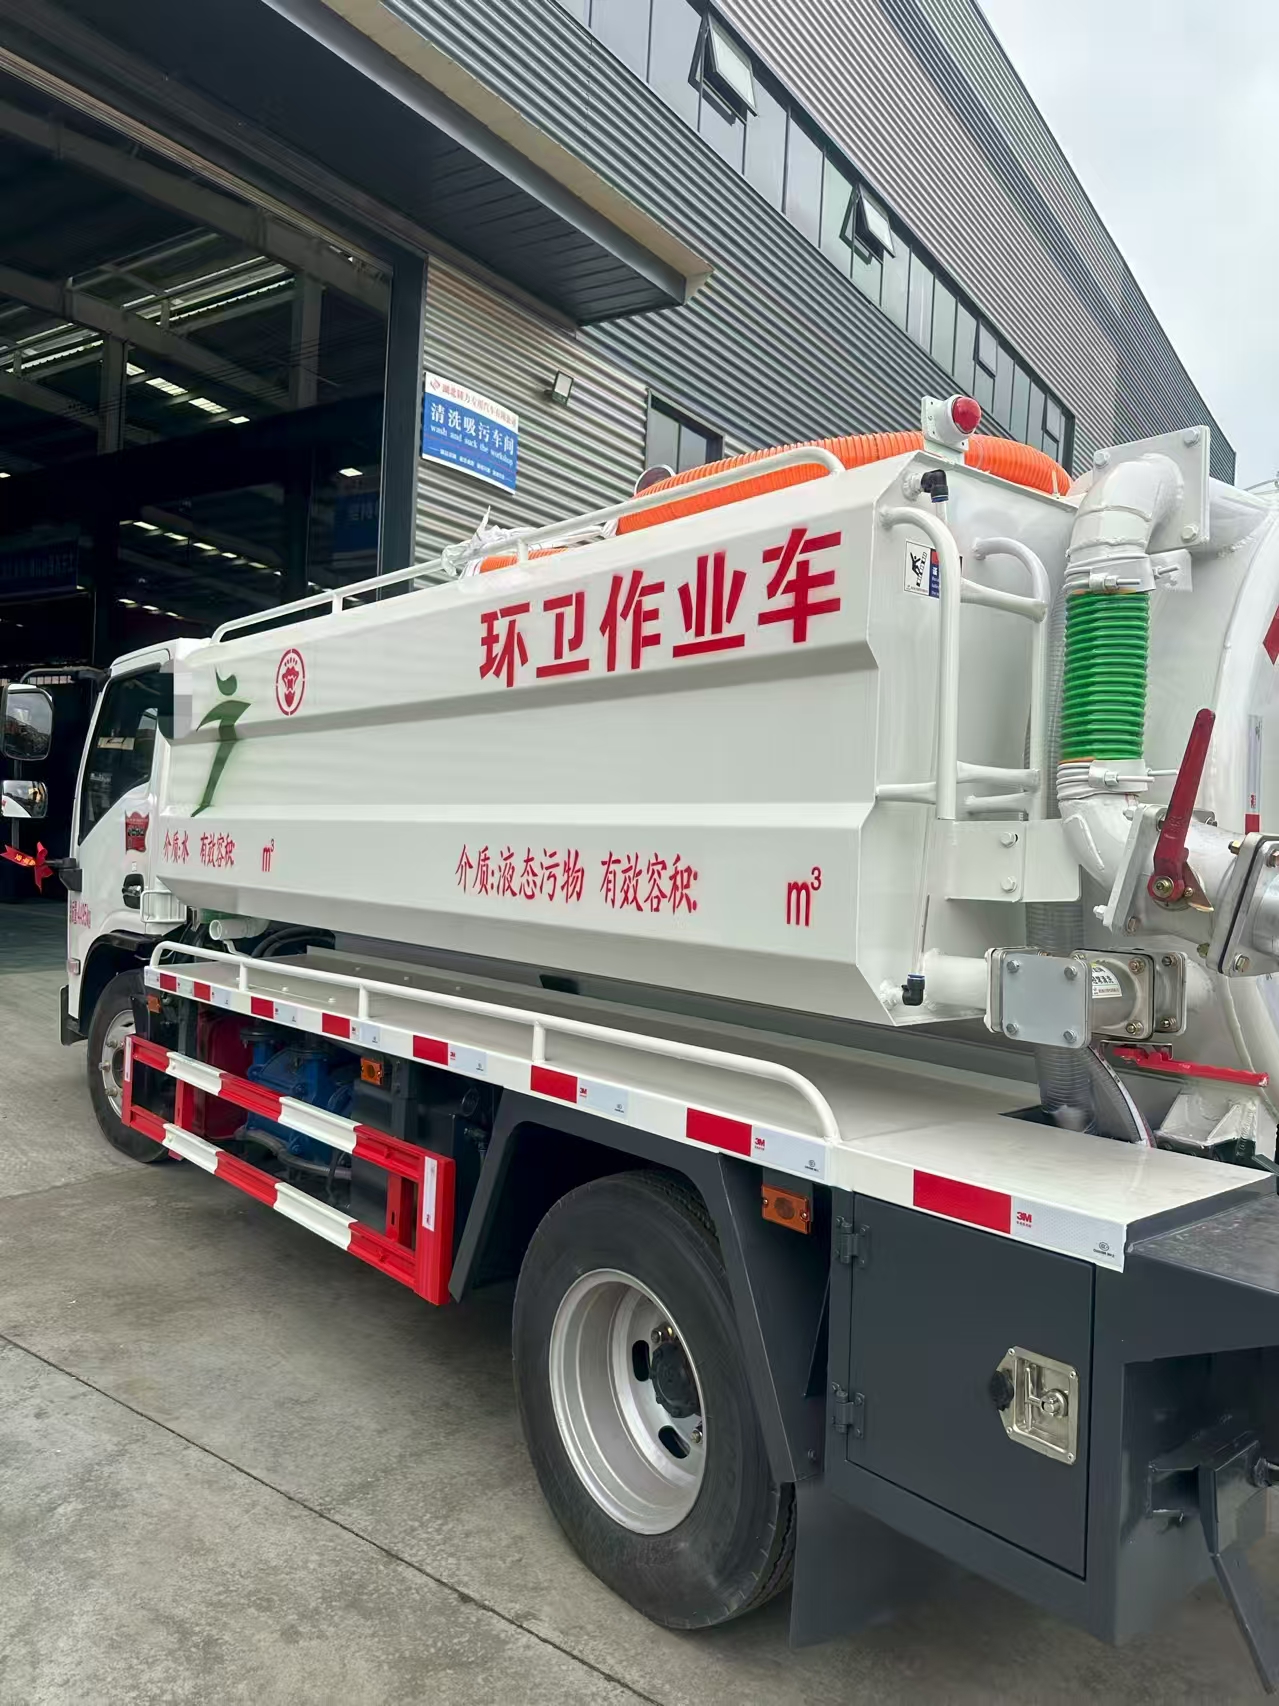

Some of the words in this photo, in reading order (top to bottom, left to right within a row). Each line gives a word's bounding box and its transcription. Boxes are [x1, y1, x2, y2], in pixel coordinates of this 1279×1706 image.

[430, 403, 514, 456] 清洗吸污车间
[430, 425, 448, 437] wash
[450, 432, 462, 442] and
[464, 437, 478, 449] suck
[480, 443, 489, 453] the
[490, 448, 514, 469] workshop
[479, 528, 842, 688] 环卫作业车
[455, 844, 585, 904] 介质:液态污物
[754, 1137, 766, 1147] 3M
[1016, 1211, 1032, 1223] 3M
